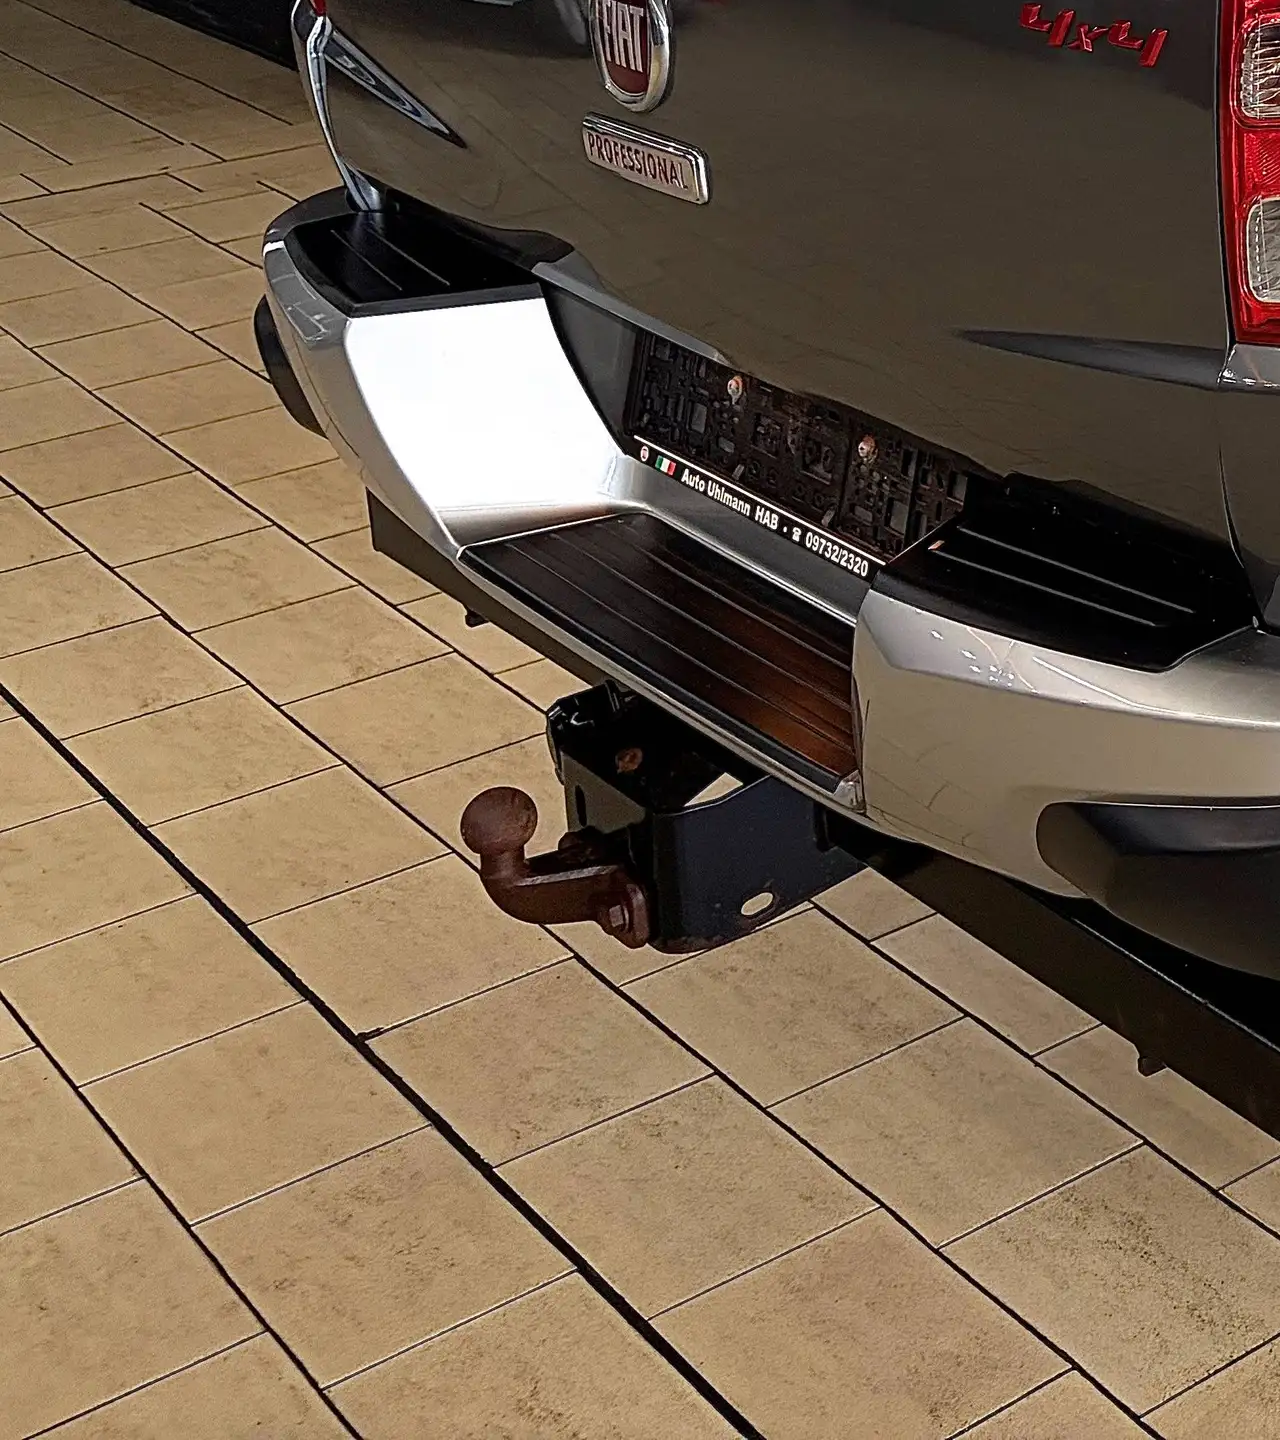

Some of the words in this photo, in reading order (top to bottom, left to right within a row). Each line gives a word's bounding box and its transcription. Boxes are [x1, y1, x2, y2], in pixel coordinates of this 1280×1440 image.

[1020, 2, 1168, 67] 4x4
[587, 131, 689, 190] PROFESSIONAL
[681, 468, 705, 492] Auto
[707, 480, 751, 517] Uhlmann
[754, 505, 779, 531] HAB
[805, 531, 869, 578] 09732/2320
